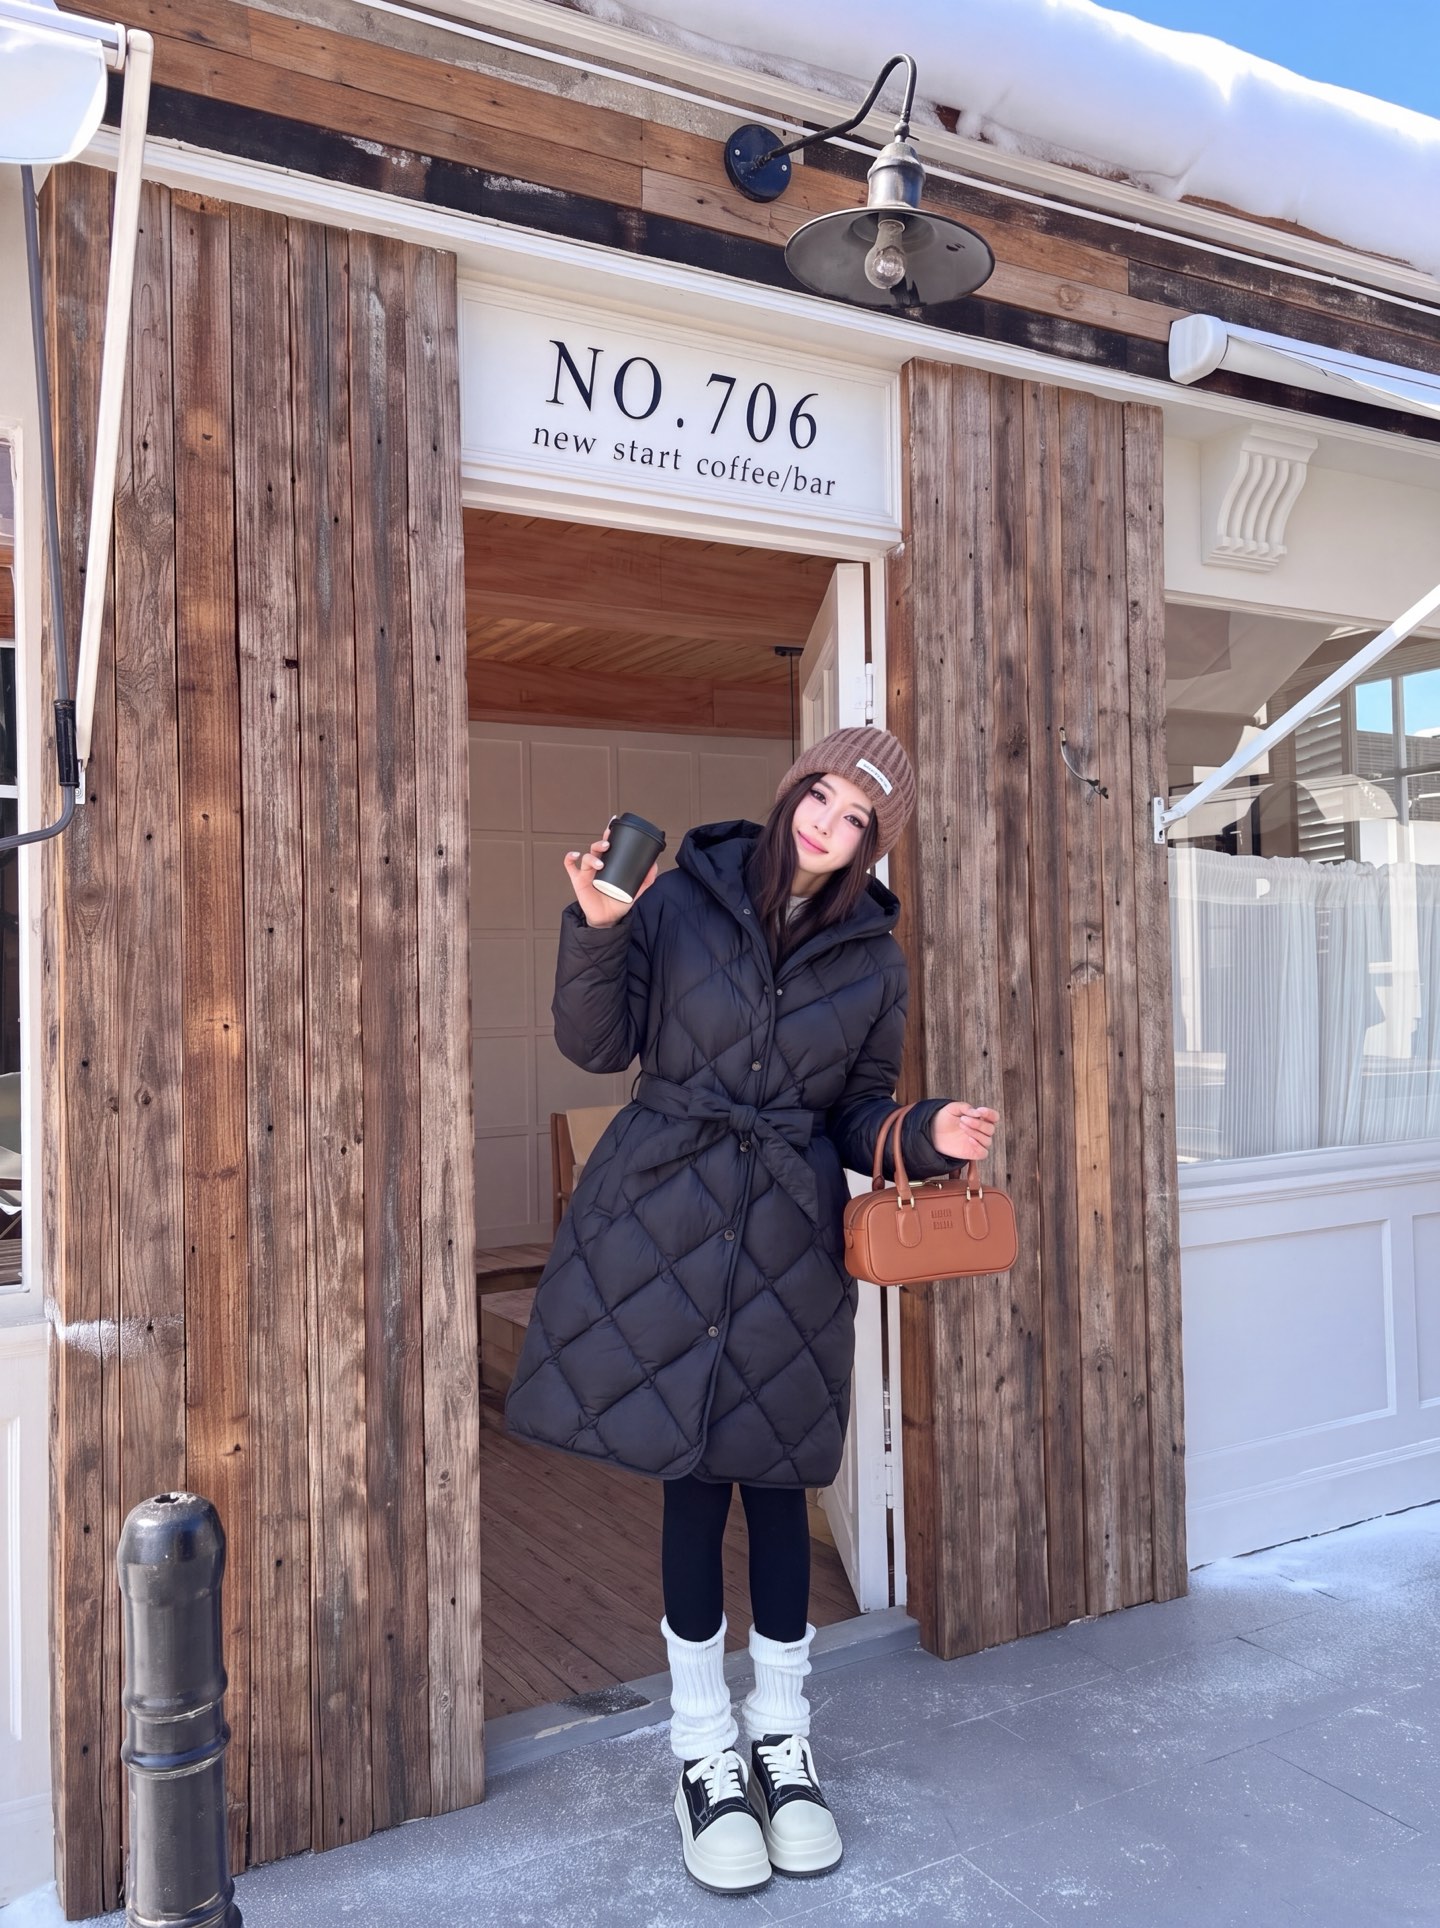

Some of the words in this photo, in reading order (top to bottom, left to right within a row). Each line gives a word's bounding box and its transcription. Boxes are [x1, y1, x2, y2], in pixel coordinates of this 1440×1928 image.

[532, 426, 597, 454] new
[612, 439, 682, 470] start
[696, 455, 836, 496] coffee/bar
